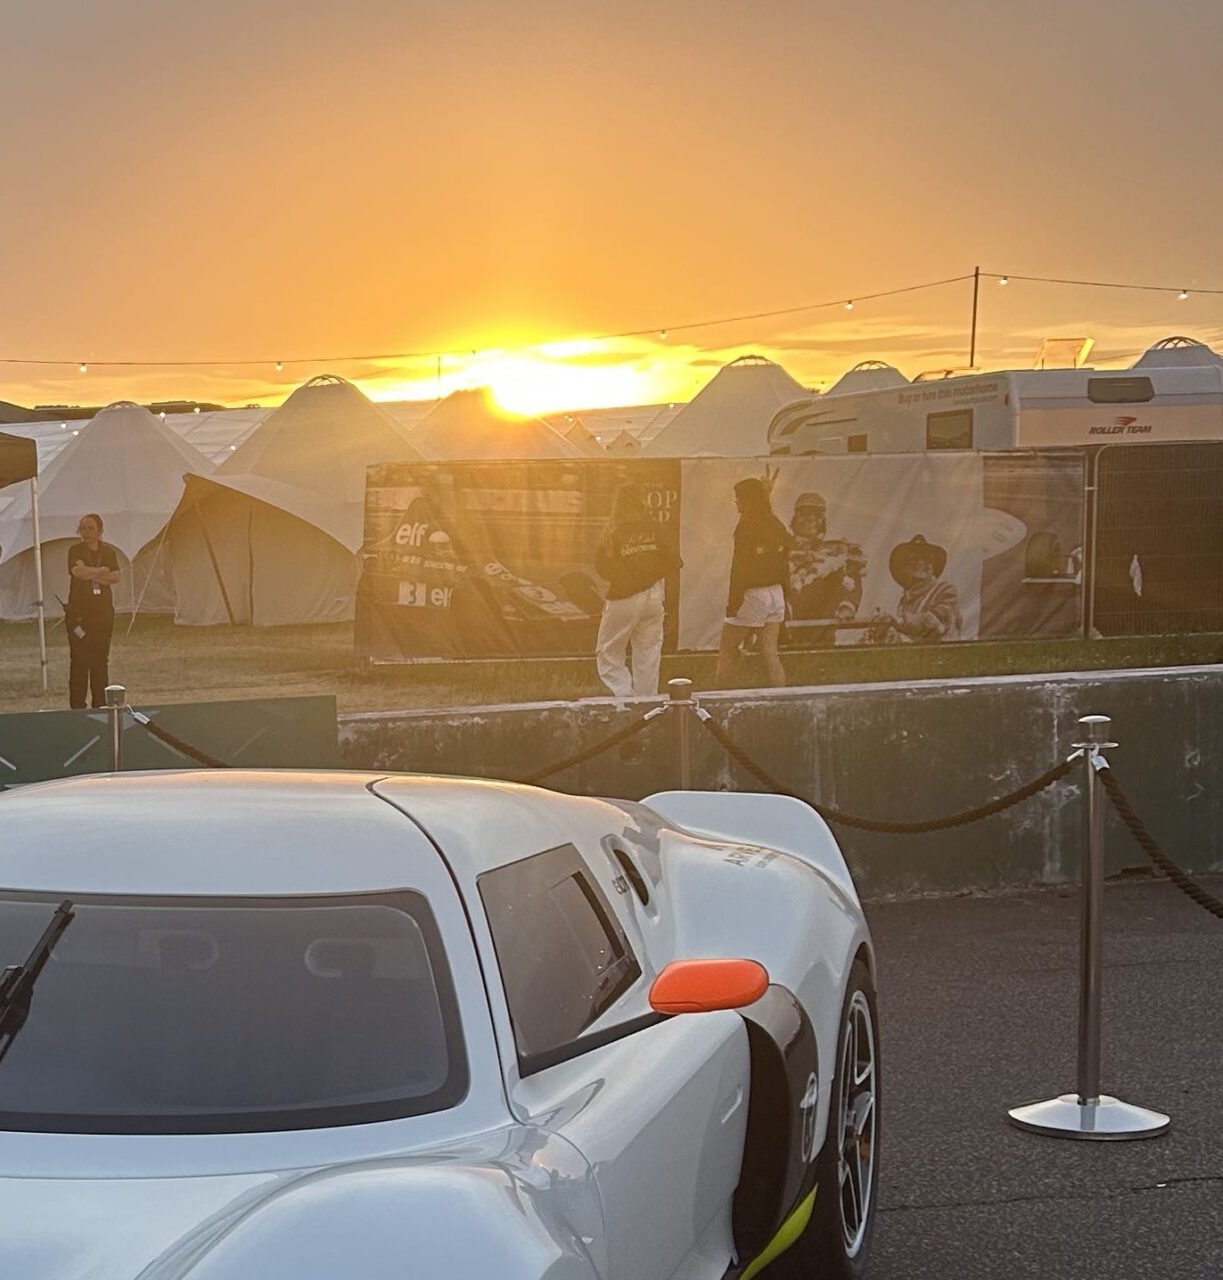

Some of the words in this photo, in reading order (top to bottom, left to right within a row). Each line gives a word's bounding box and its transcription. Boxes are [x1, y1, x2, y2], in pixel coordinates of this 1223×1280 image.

[1088, 426, 1125, 435] ROLLER
[1126, 425, 1152, 434] TEAM
[395, 522, 429, 547] elf
